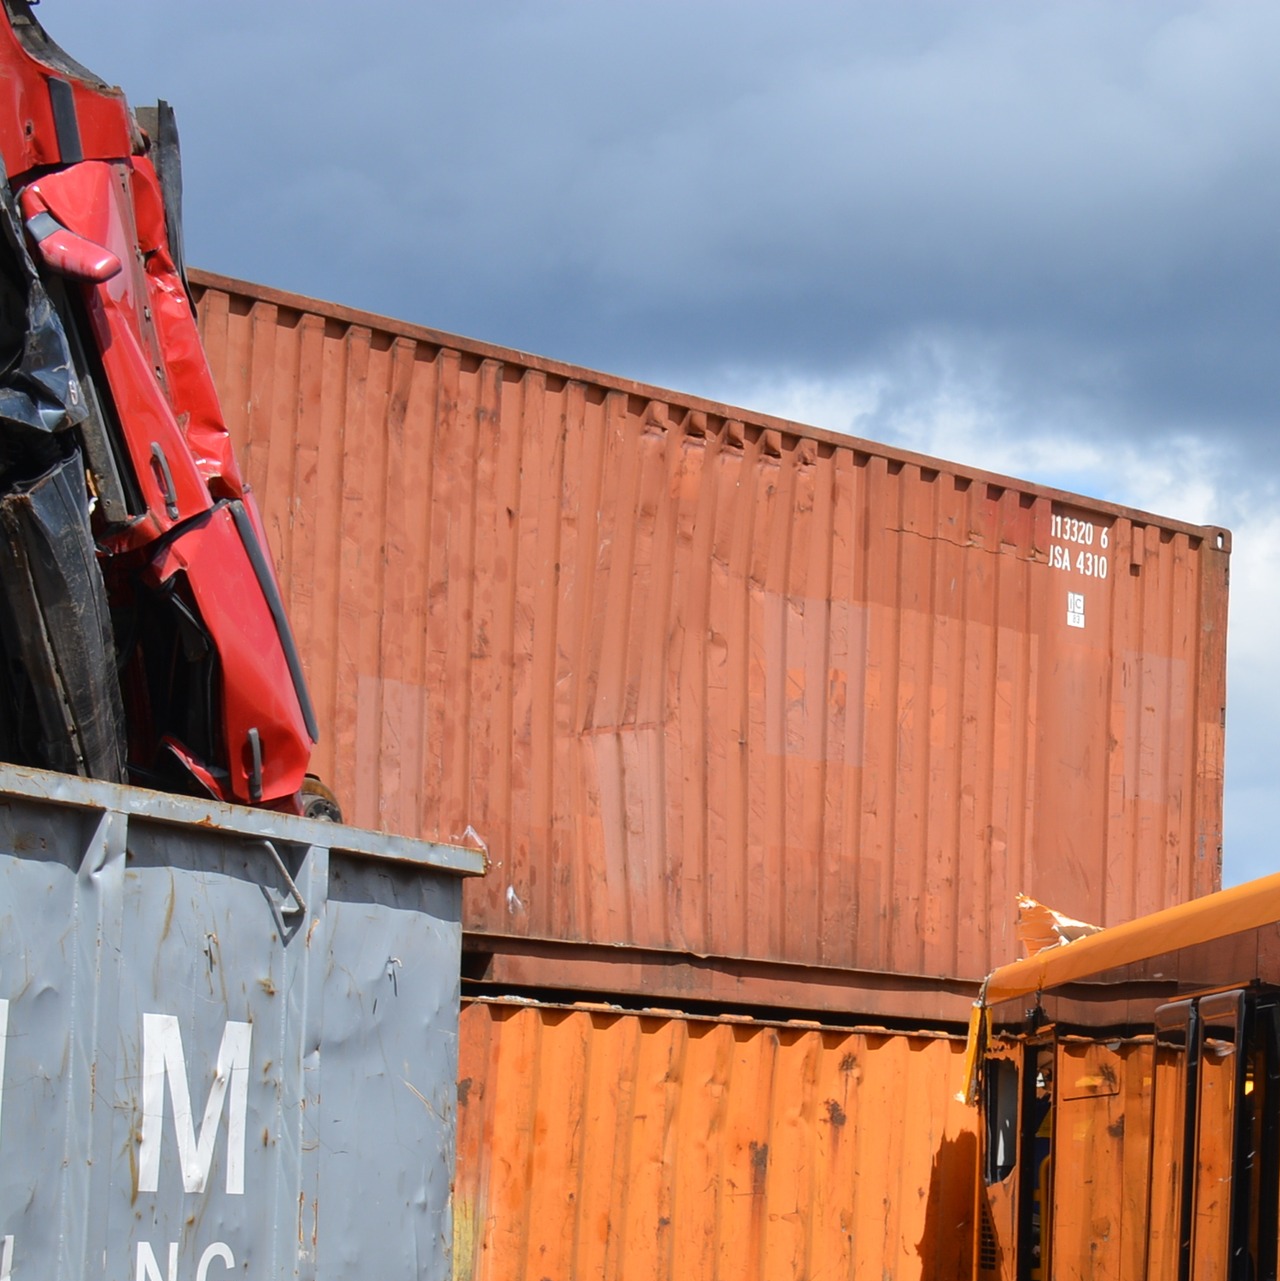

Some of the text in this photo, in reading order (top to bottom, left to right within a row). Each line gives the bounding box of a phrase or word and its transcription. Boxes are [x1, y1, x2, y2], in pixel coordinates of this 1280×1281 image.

[1051, 514, 1109, 549] 113320 6
[1076, 551, 1107, 579] 4310
[138, 1013, 253, 1195] M
